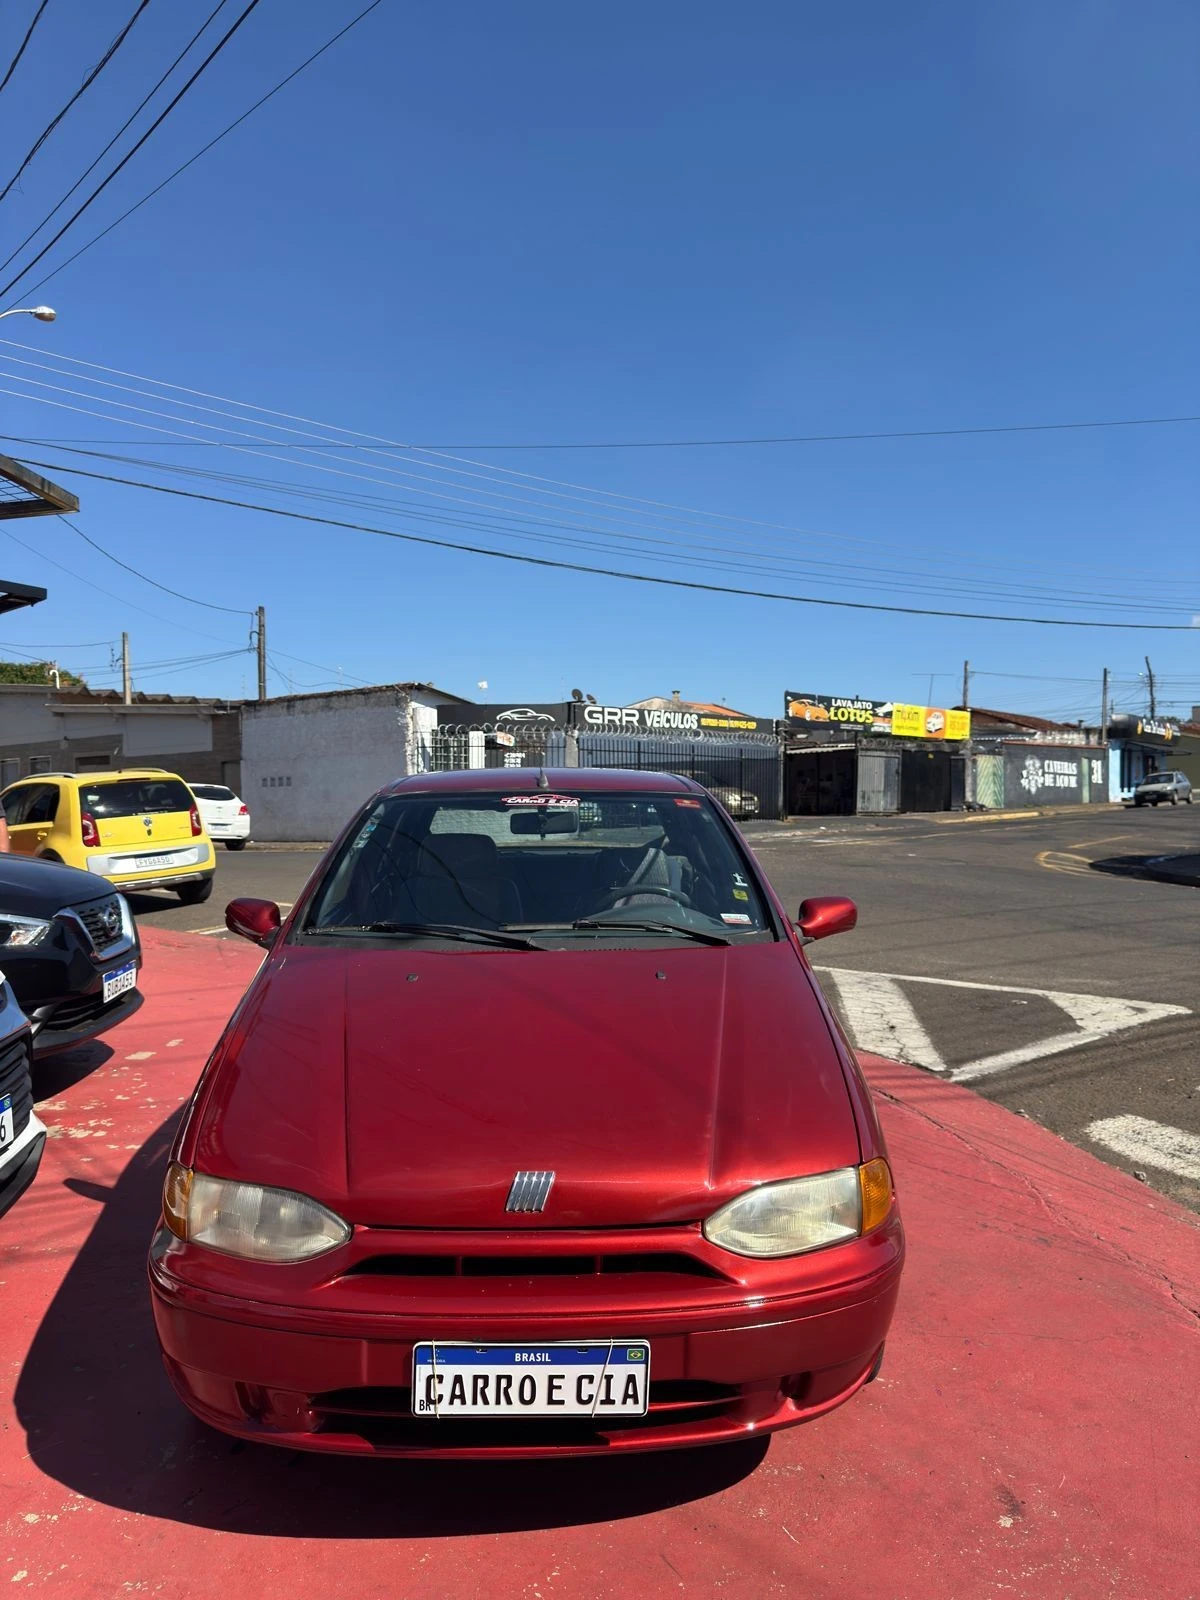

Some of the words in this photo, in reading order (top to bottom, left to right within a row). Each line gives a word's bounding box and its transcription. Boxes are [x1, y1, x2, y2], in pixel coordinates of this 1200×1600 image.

[584, 706, 640, 726] GRR
[644, 709, 699, 729] VEÍCULOS
[829, 706, 874, 723] LOTUS
[514, 1352, 552, 1362] BRASIL
[425, 1374, 537, 1406] CARRO
[547, 1374, 566, 1406] E
[576, 1374, 640, 1406] CIA
[418, 1400, 431, 1412] BR
